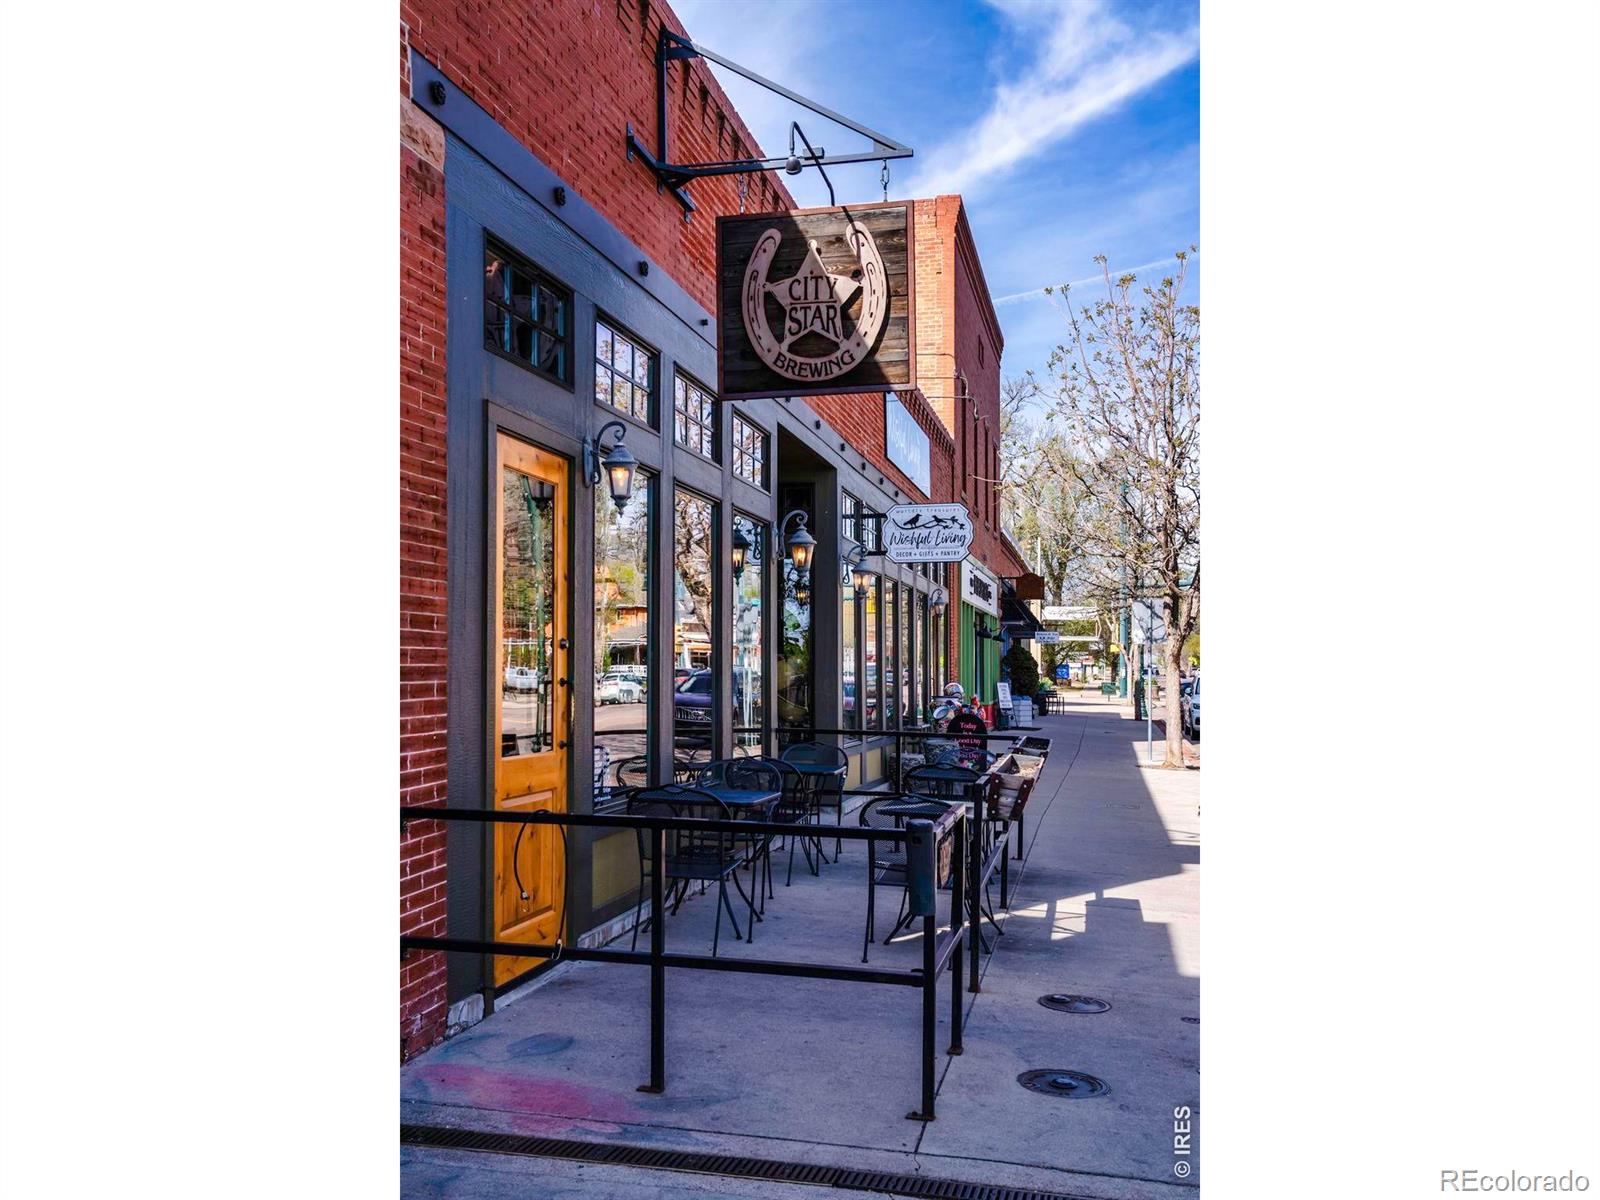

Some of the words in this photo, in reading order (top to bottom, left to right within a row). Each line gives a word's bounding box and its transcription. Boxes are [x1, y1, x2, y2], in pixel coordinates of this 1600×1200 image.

[788, 276, 838, 300] CITY
[787, 305, 840, 338] STAR
[773, 350, 856, 378] BREWING
[889, 531, 931, 549] Wishful
[935, 530, 967, 547] Living
[960, 721, 977, 730] Today
